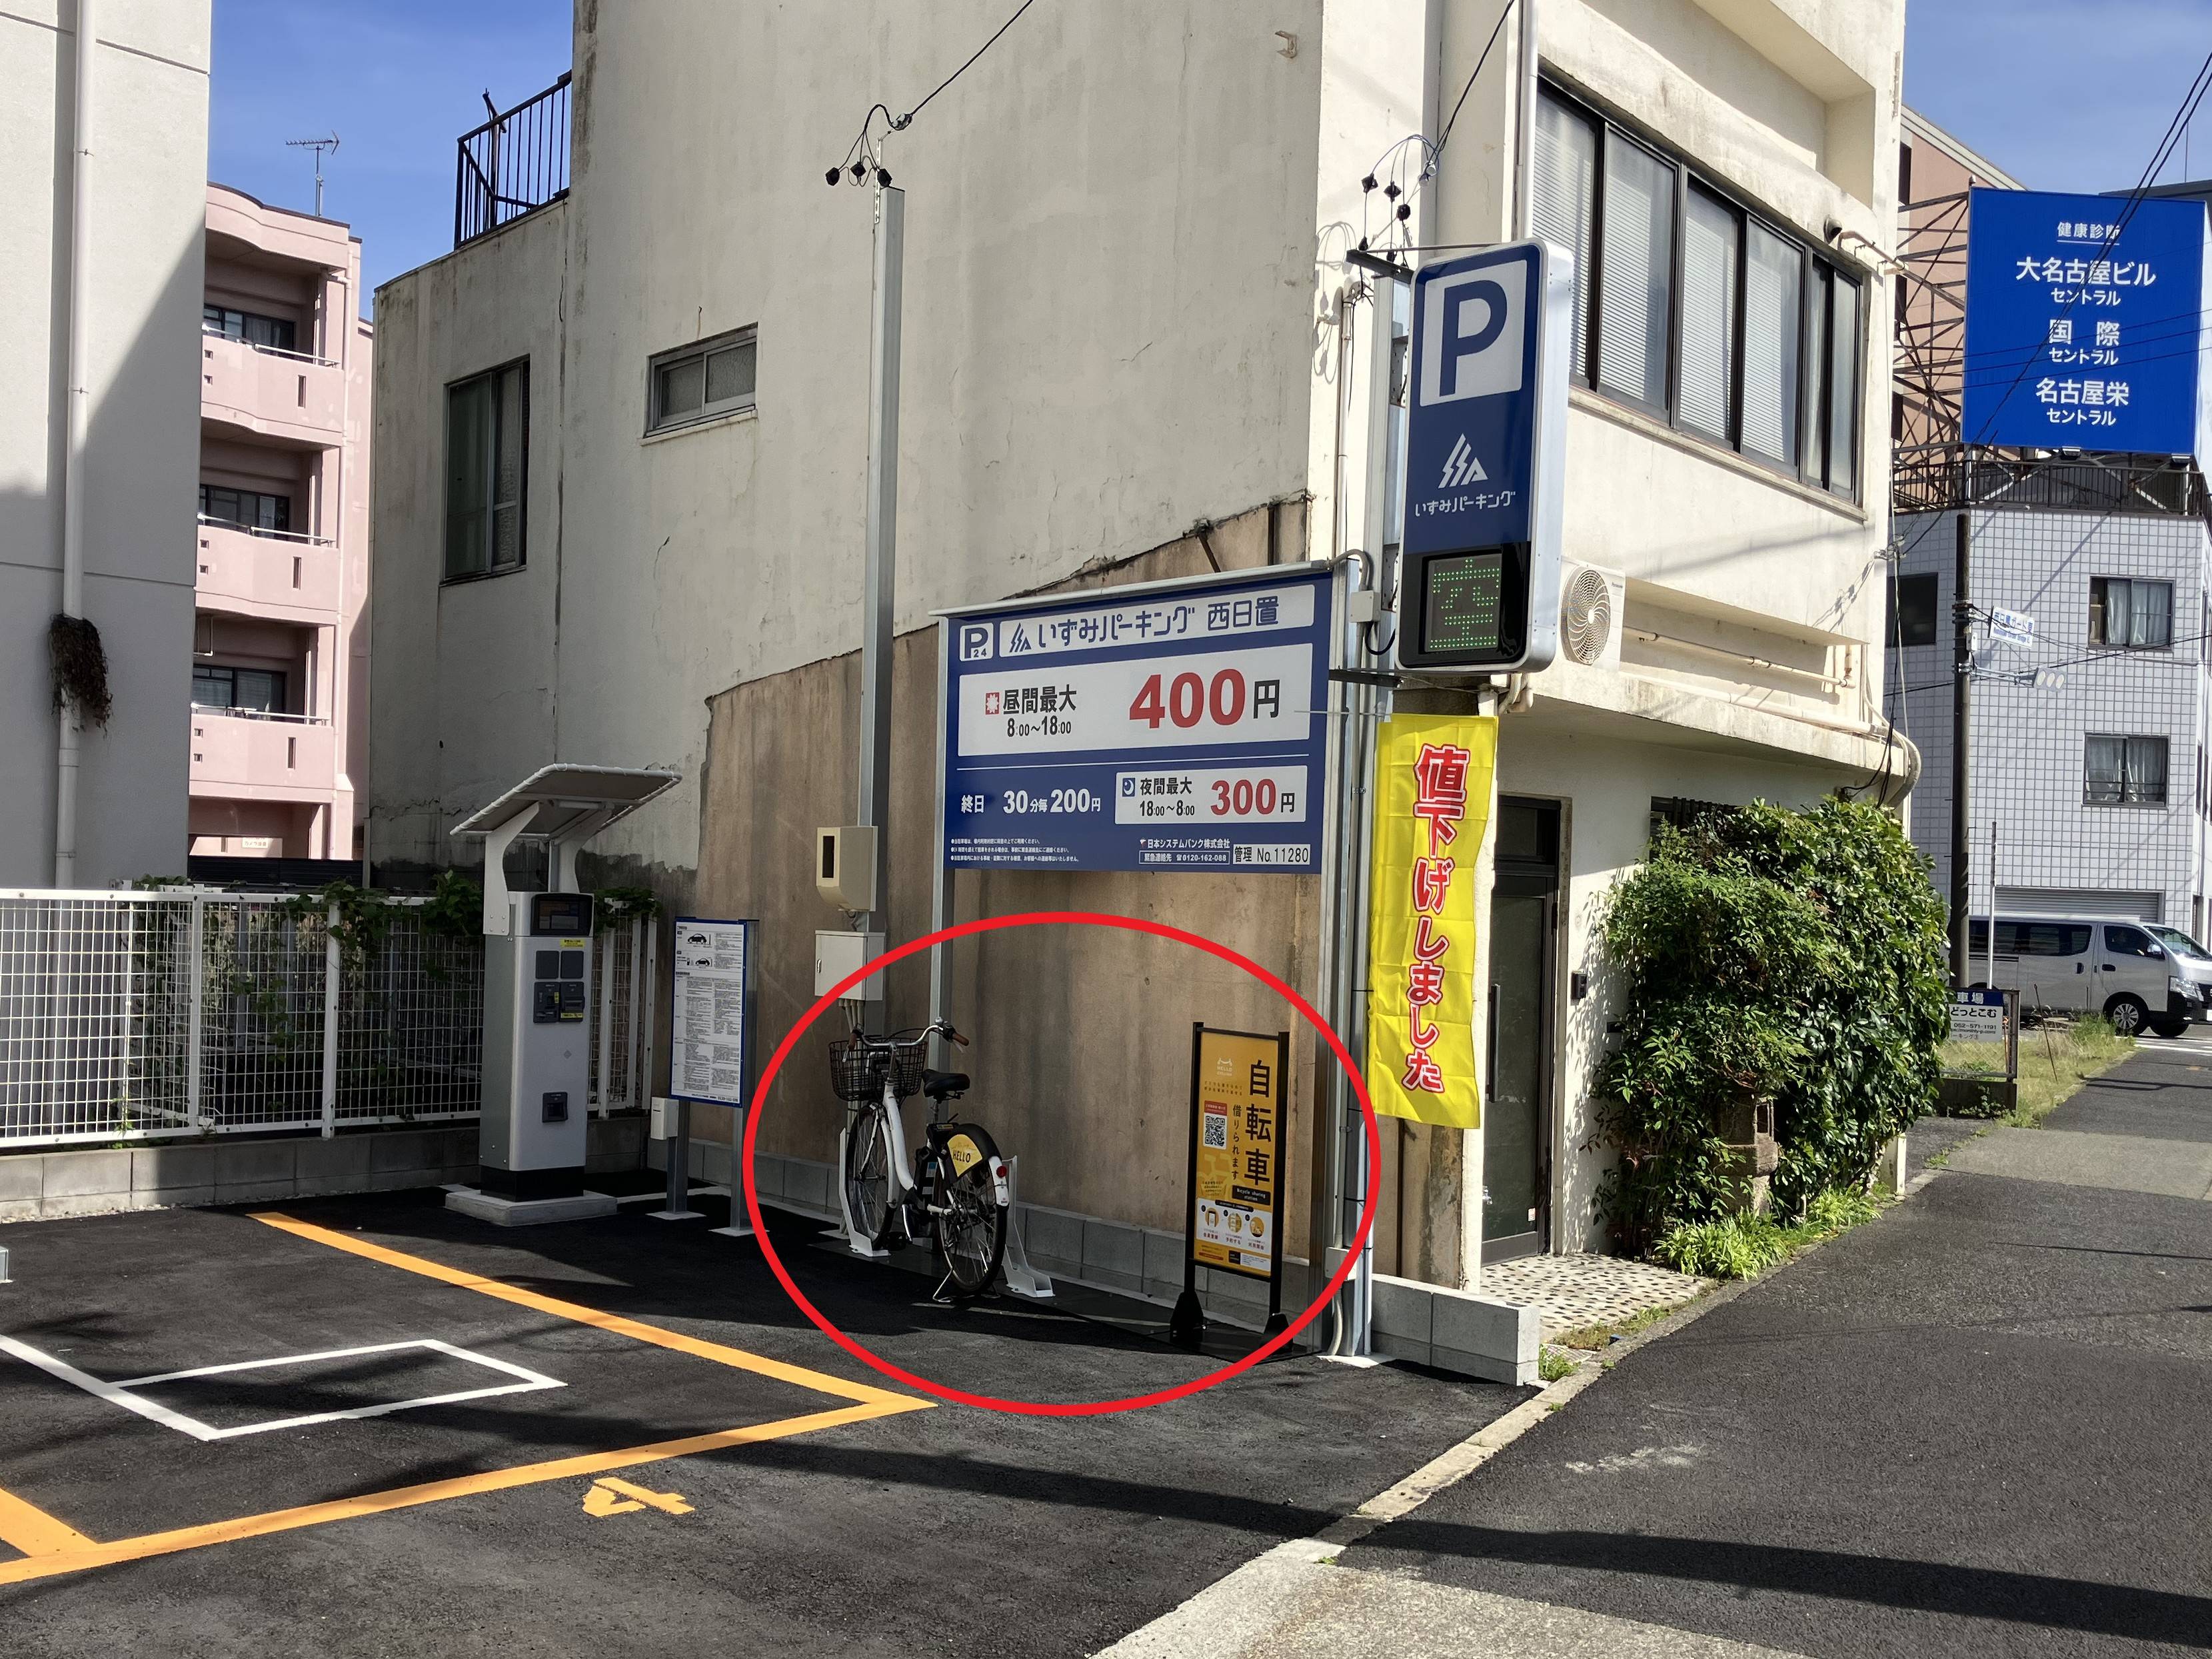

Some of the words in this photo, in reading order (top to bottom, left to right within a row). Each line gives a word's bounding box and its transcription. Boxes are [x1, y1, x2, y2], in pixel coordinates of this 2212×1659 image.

[2057, 222, 2121, 240] 健康診断
[2015, 256, 2156, 287] 大名古屋ビル
[2051, 287, 2121, 307] セントラル
[1439, 280, 1508, 397] P
[2048, 347, 2119, 366] セントラル
[2035, 377, 2130, 407] 名古屋栄
[2046, 407, 2117, 427] セントラル
[1415, 490, 1517, 518] いずみパーキング
[1038, 606, 1195, 648] いずみパーキング
[1208, 595, 1279, 631] 西日置
[964, 627, 988, 659] P
[973, 648, 988, 659] 24
[1002, 684, 1077, 715] 昼間最大
[1140, 777, 1192, 796] 夜間最大
[960, 794, 985, 814] 終日
[1147, 838, 1230, 849] 日本システムバンク株式会社
[1234, 846, 1253, 863] 管理
[1402, 743, 1471, 1094] 値下げしました
[1244, 1059, 1272, 1186] 自転車
[1232, 1103, 1242, 1181] 借りられます
[952, 1150, 971, 1163] HELLO
